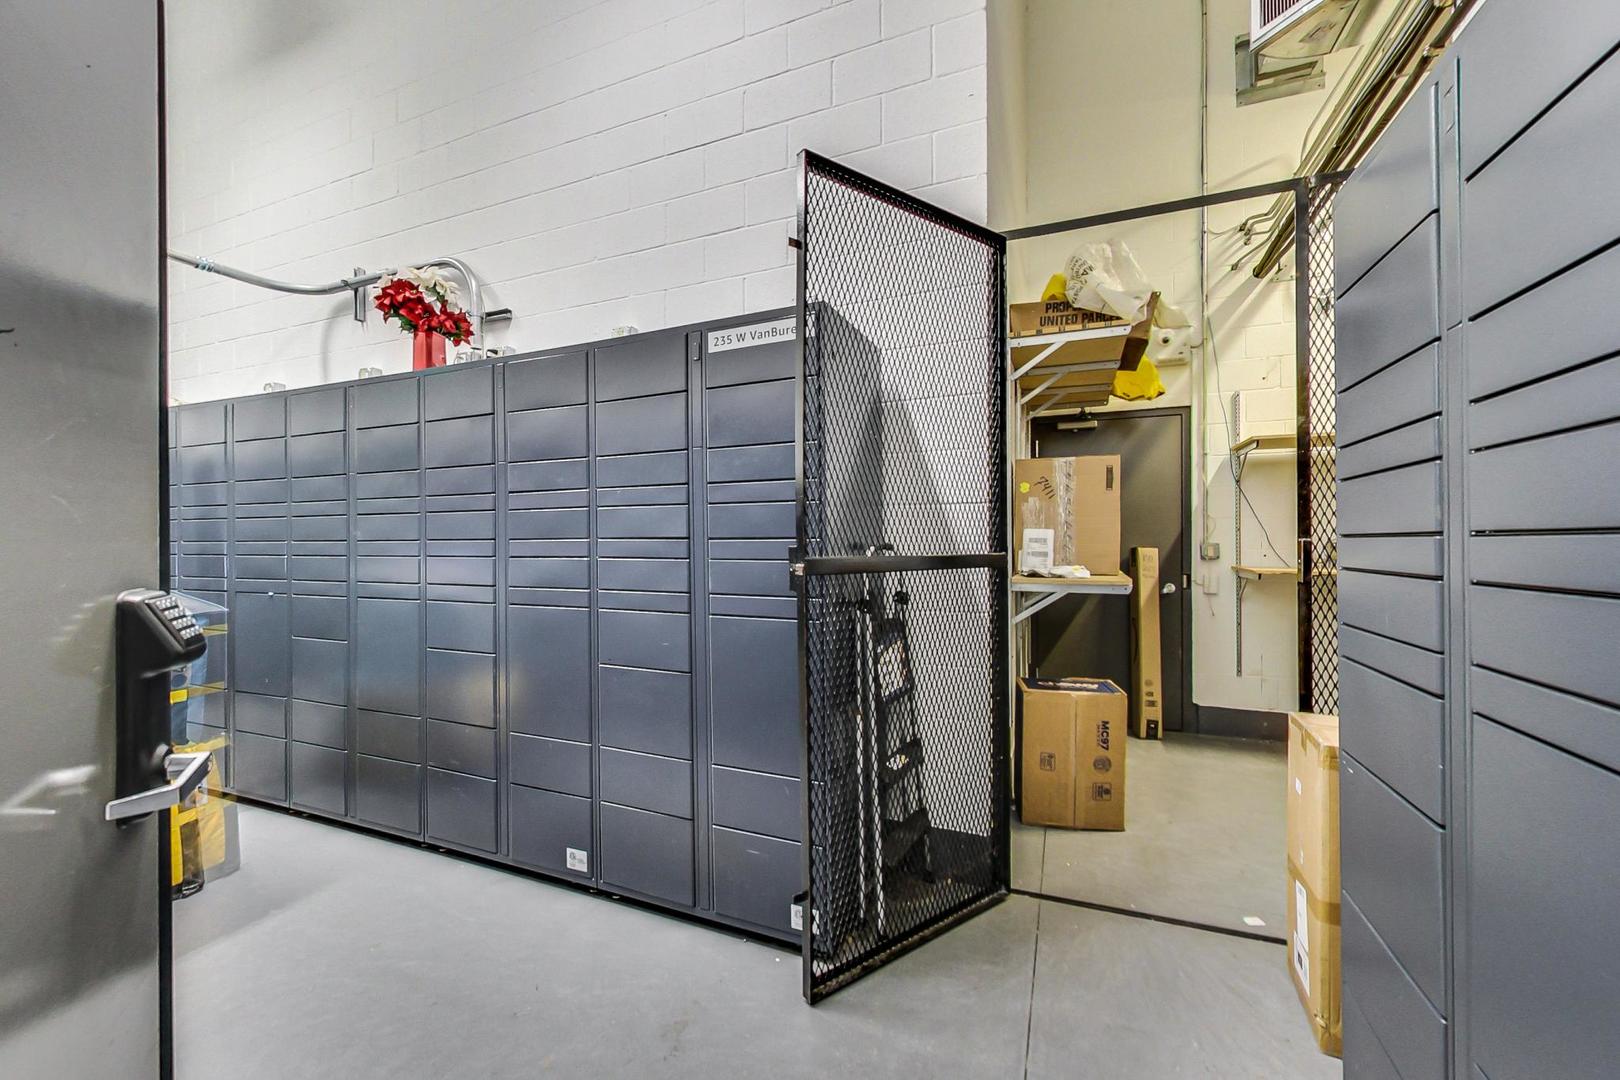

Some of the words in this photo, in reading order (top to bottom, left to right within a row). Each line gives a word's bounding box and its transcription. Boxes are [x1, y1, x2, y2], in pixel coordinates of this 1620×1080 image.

[1045, 302, 1077, 313] PROP
[1040, 314, 1078, 326] UNITED
[713, 335, 733, 347] 235
[736, 332, 746, 342] W
[1101, 720, 1110, 751] MC97
